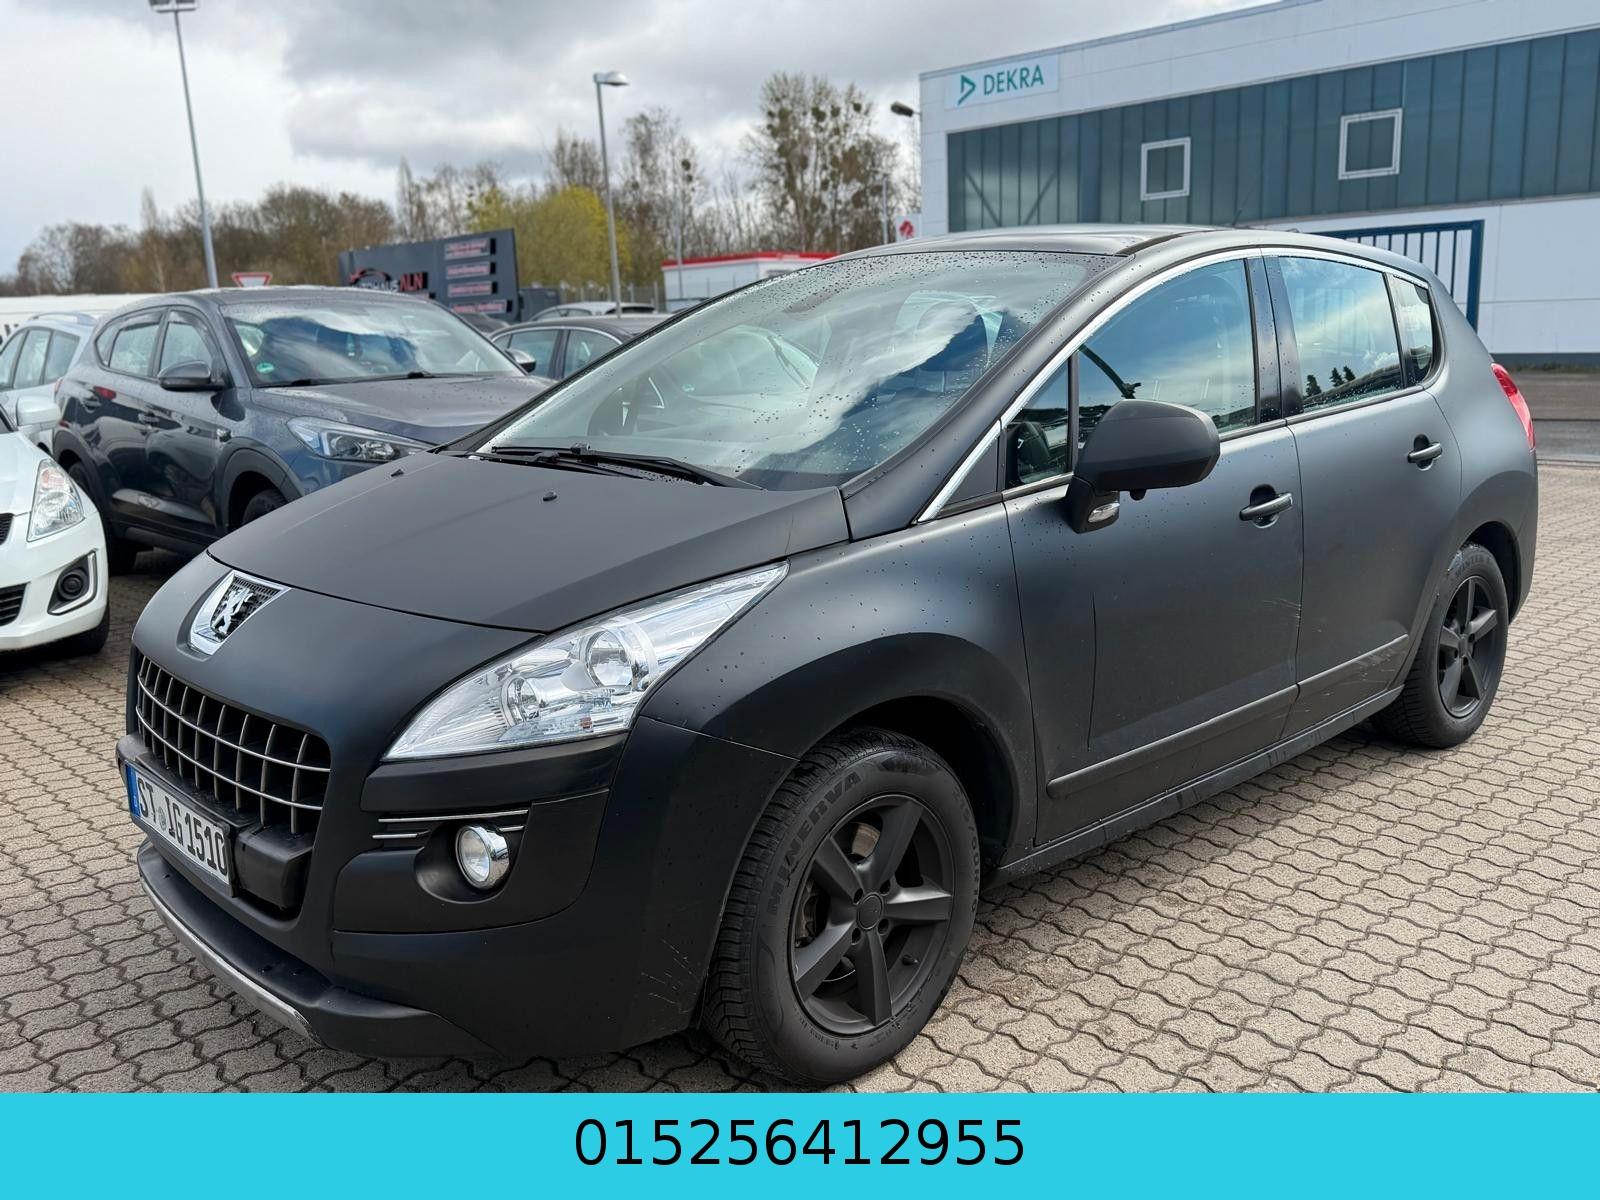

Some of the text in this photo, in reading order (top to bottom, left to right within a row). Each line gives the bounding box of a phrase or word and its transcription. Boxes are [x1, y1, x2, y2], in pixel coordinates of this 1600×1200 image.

[984, 64, 1044, 95] DEKRA
[400, 272, 423, 291] ALN
[137, 778, 157, 823] ST
[767, 771, 862, 915] MINERVA
